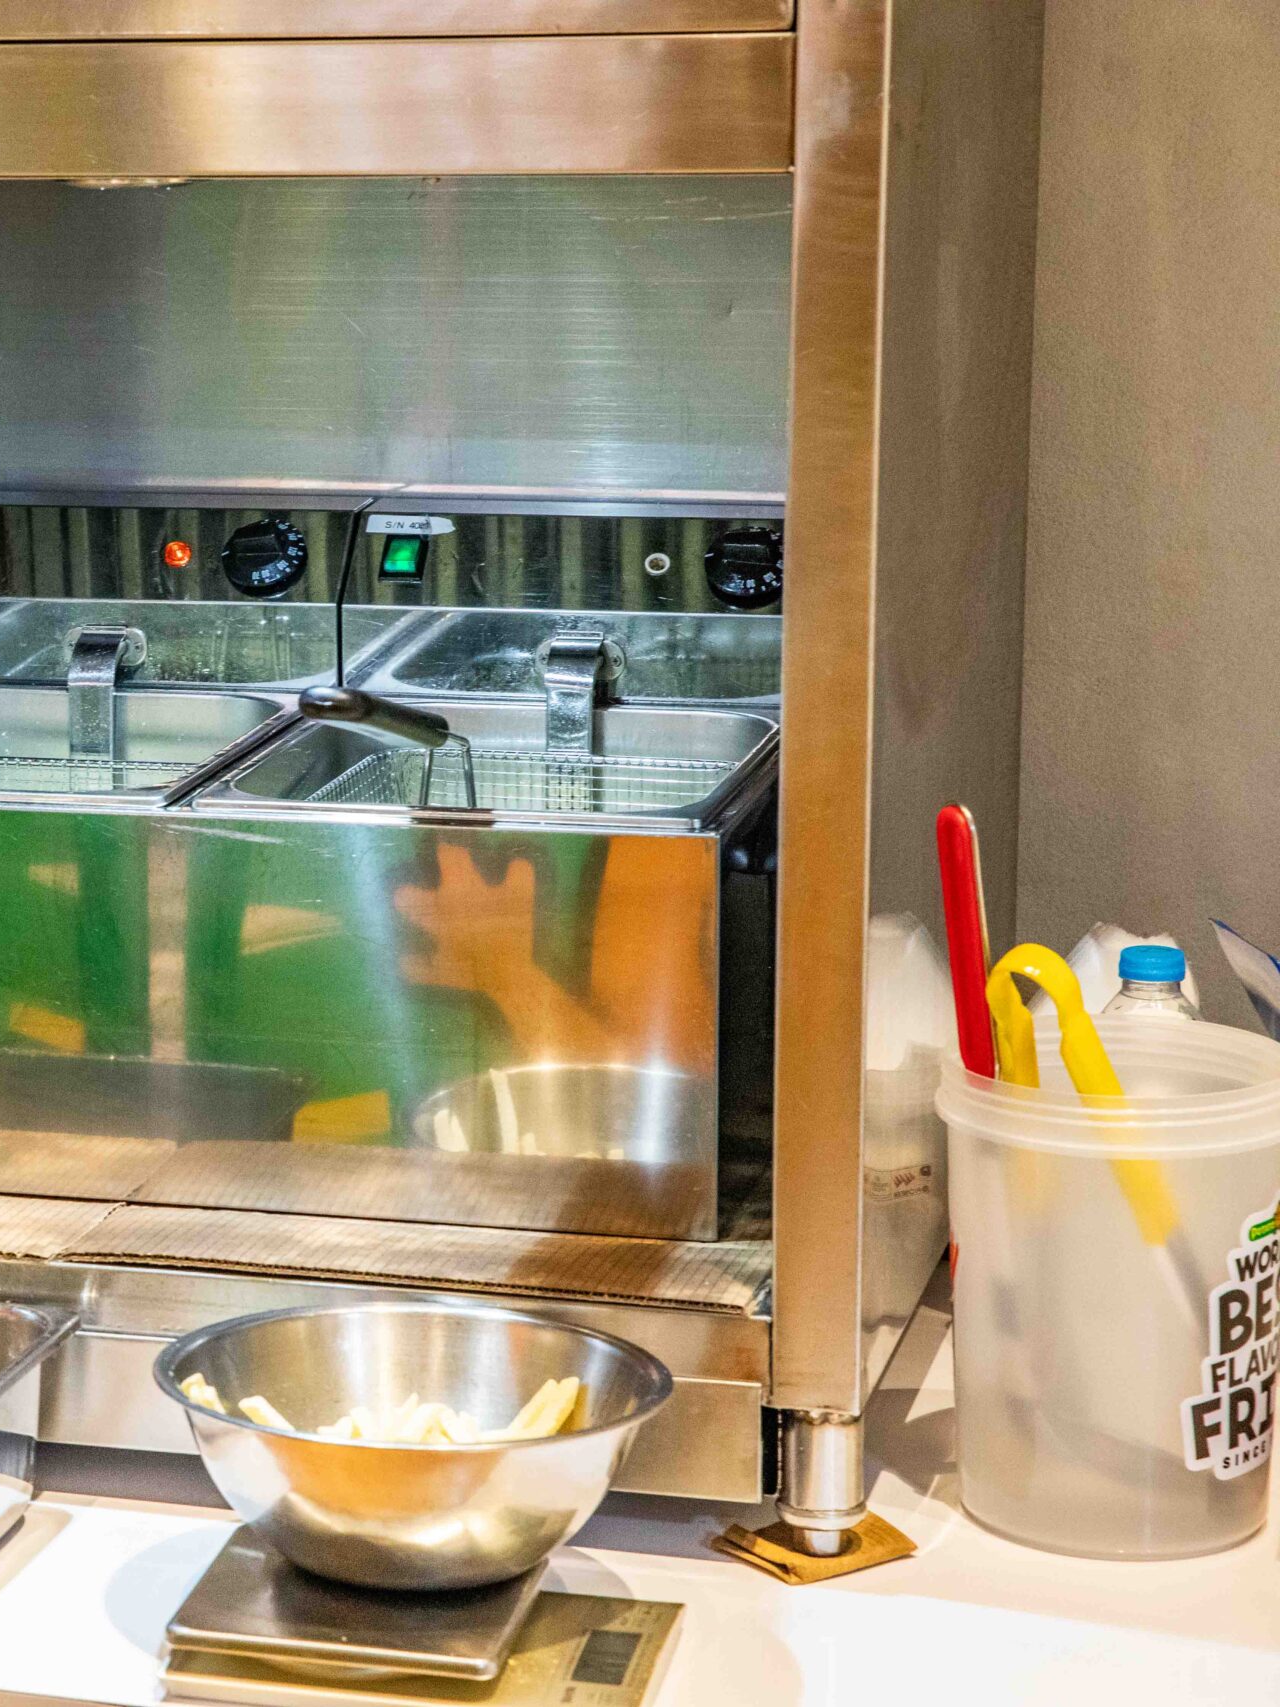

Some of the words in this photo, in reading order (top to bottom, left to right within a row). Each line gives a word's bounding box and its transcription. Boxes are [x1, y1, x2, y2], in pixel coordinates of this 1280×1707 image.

[384, 521, 405, 529] S/N
[1218, 1273, 1280, 1356] BE
[1222, 1440, 1266, 1469] SINCE
